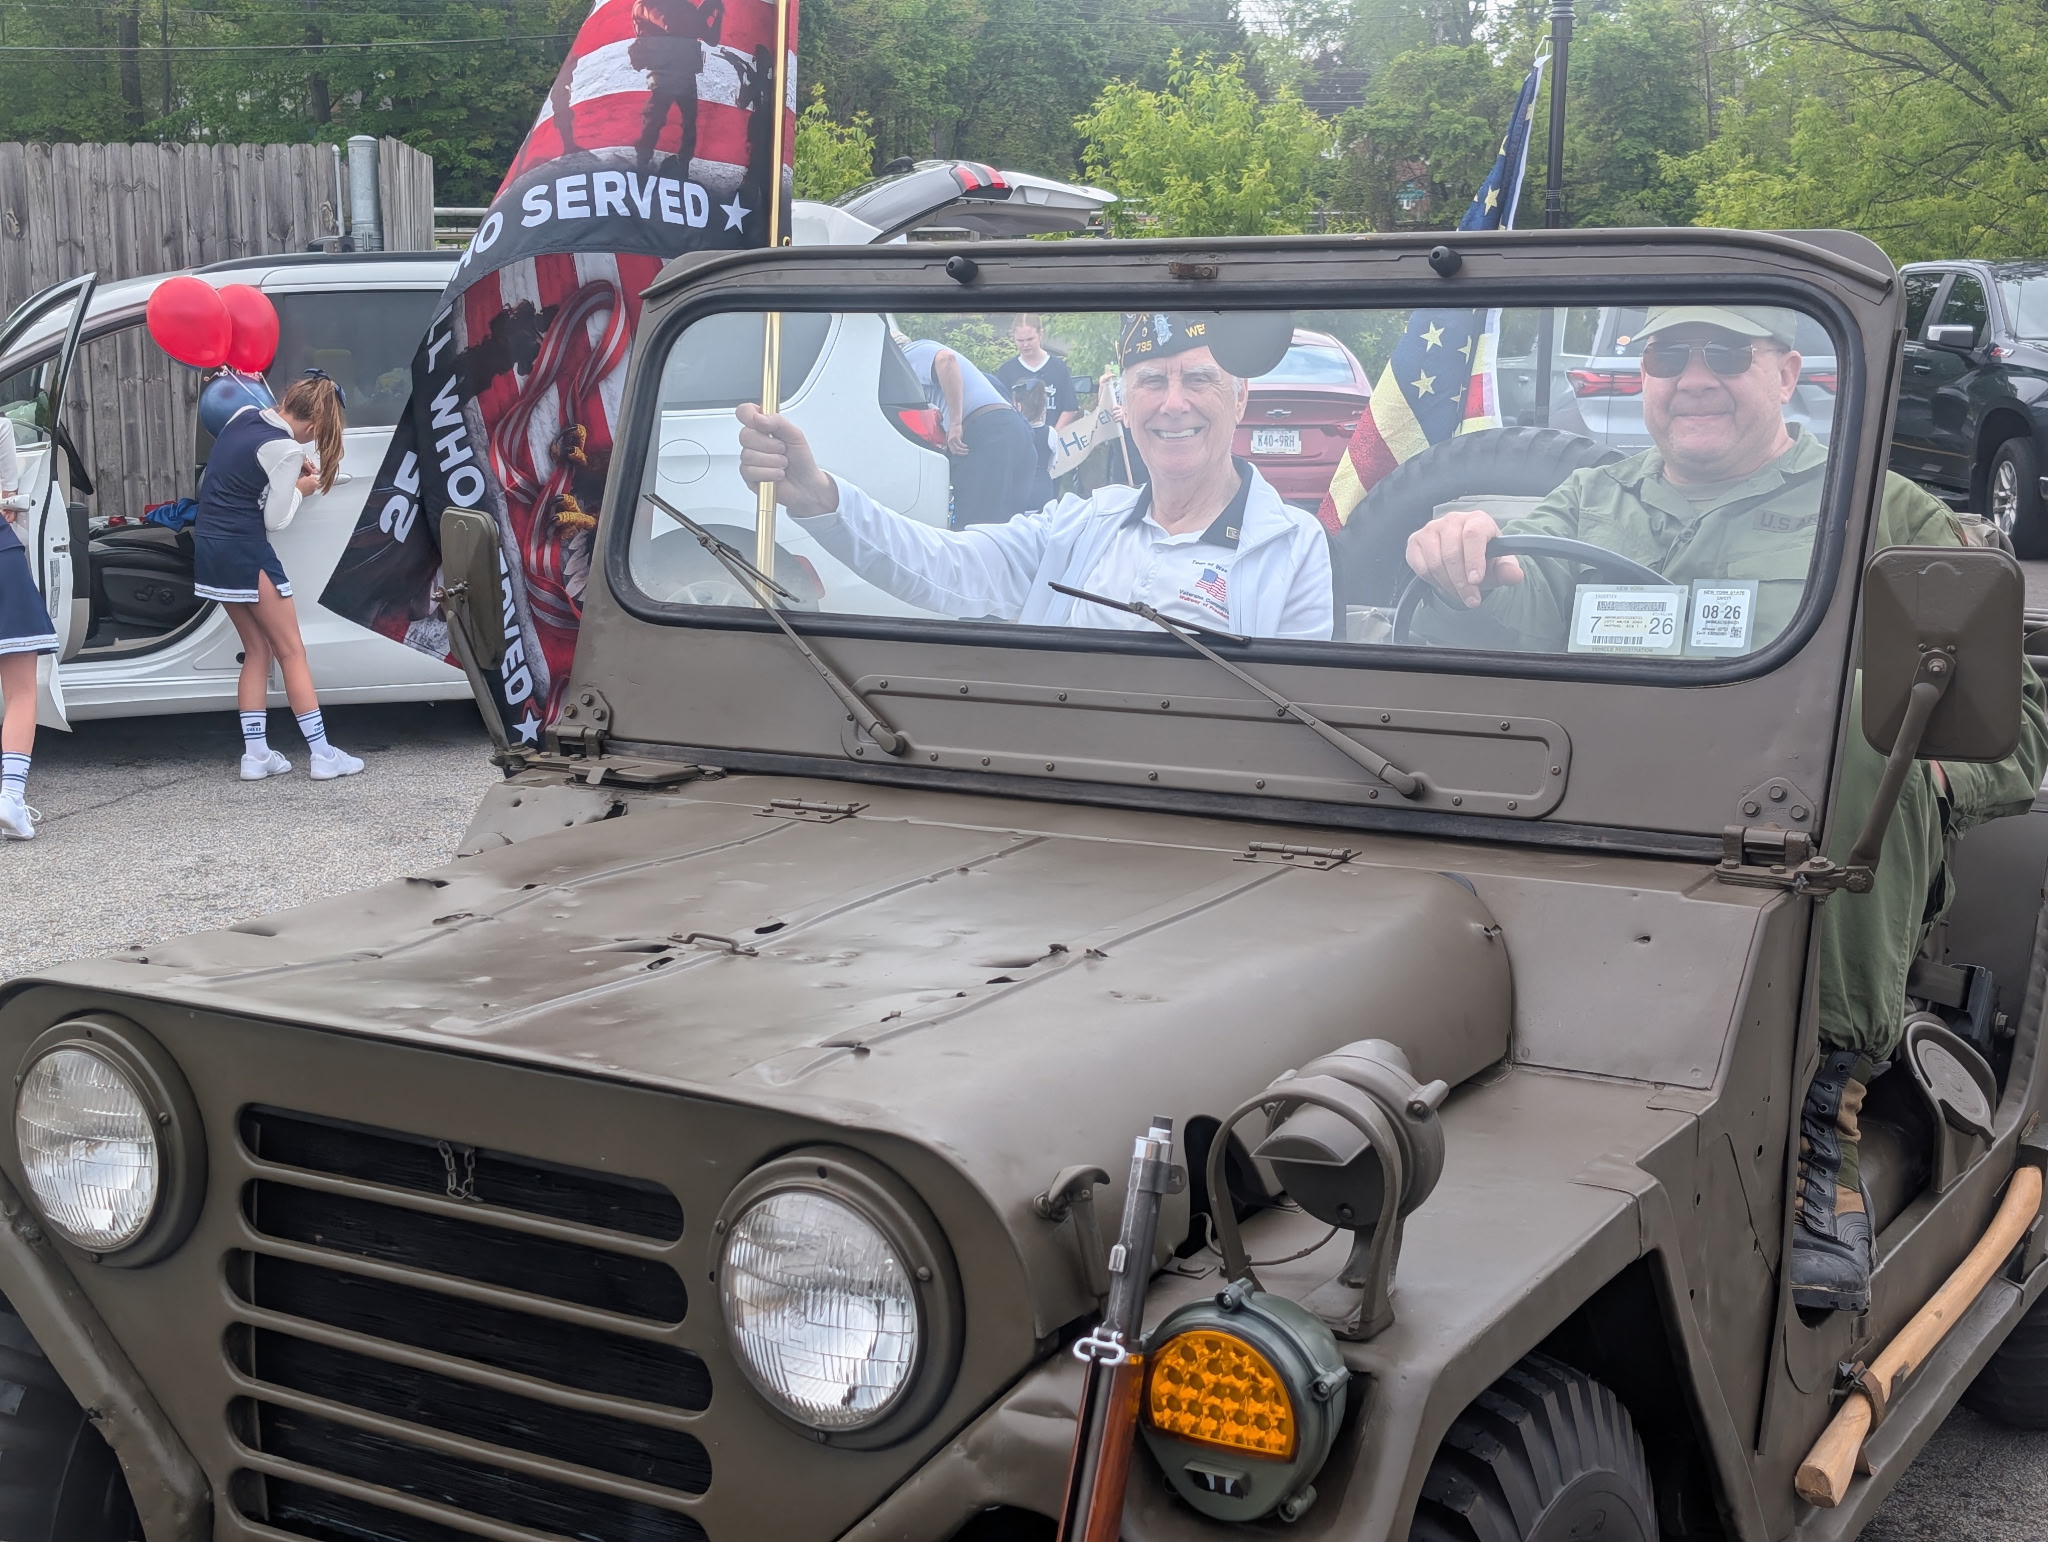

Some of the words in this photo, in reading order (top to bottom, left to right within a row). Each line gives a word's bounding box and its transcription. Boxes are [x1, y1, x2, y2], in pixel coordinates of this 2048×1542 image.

[521, 170, 709, 228] SERVED
[430, 374, 486, 507] WHO
[498, 546, 534, 706] VED
[1590, 616, 1602, 634] 7
[1648, 617, 1674, 635] 26
